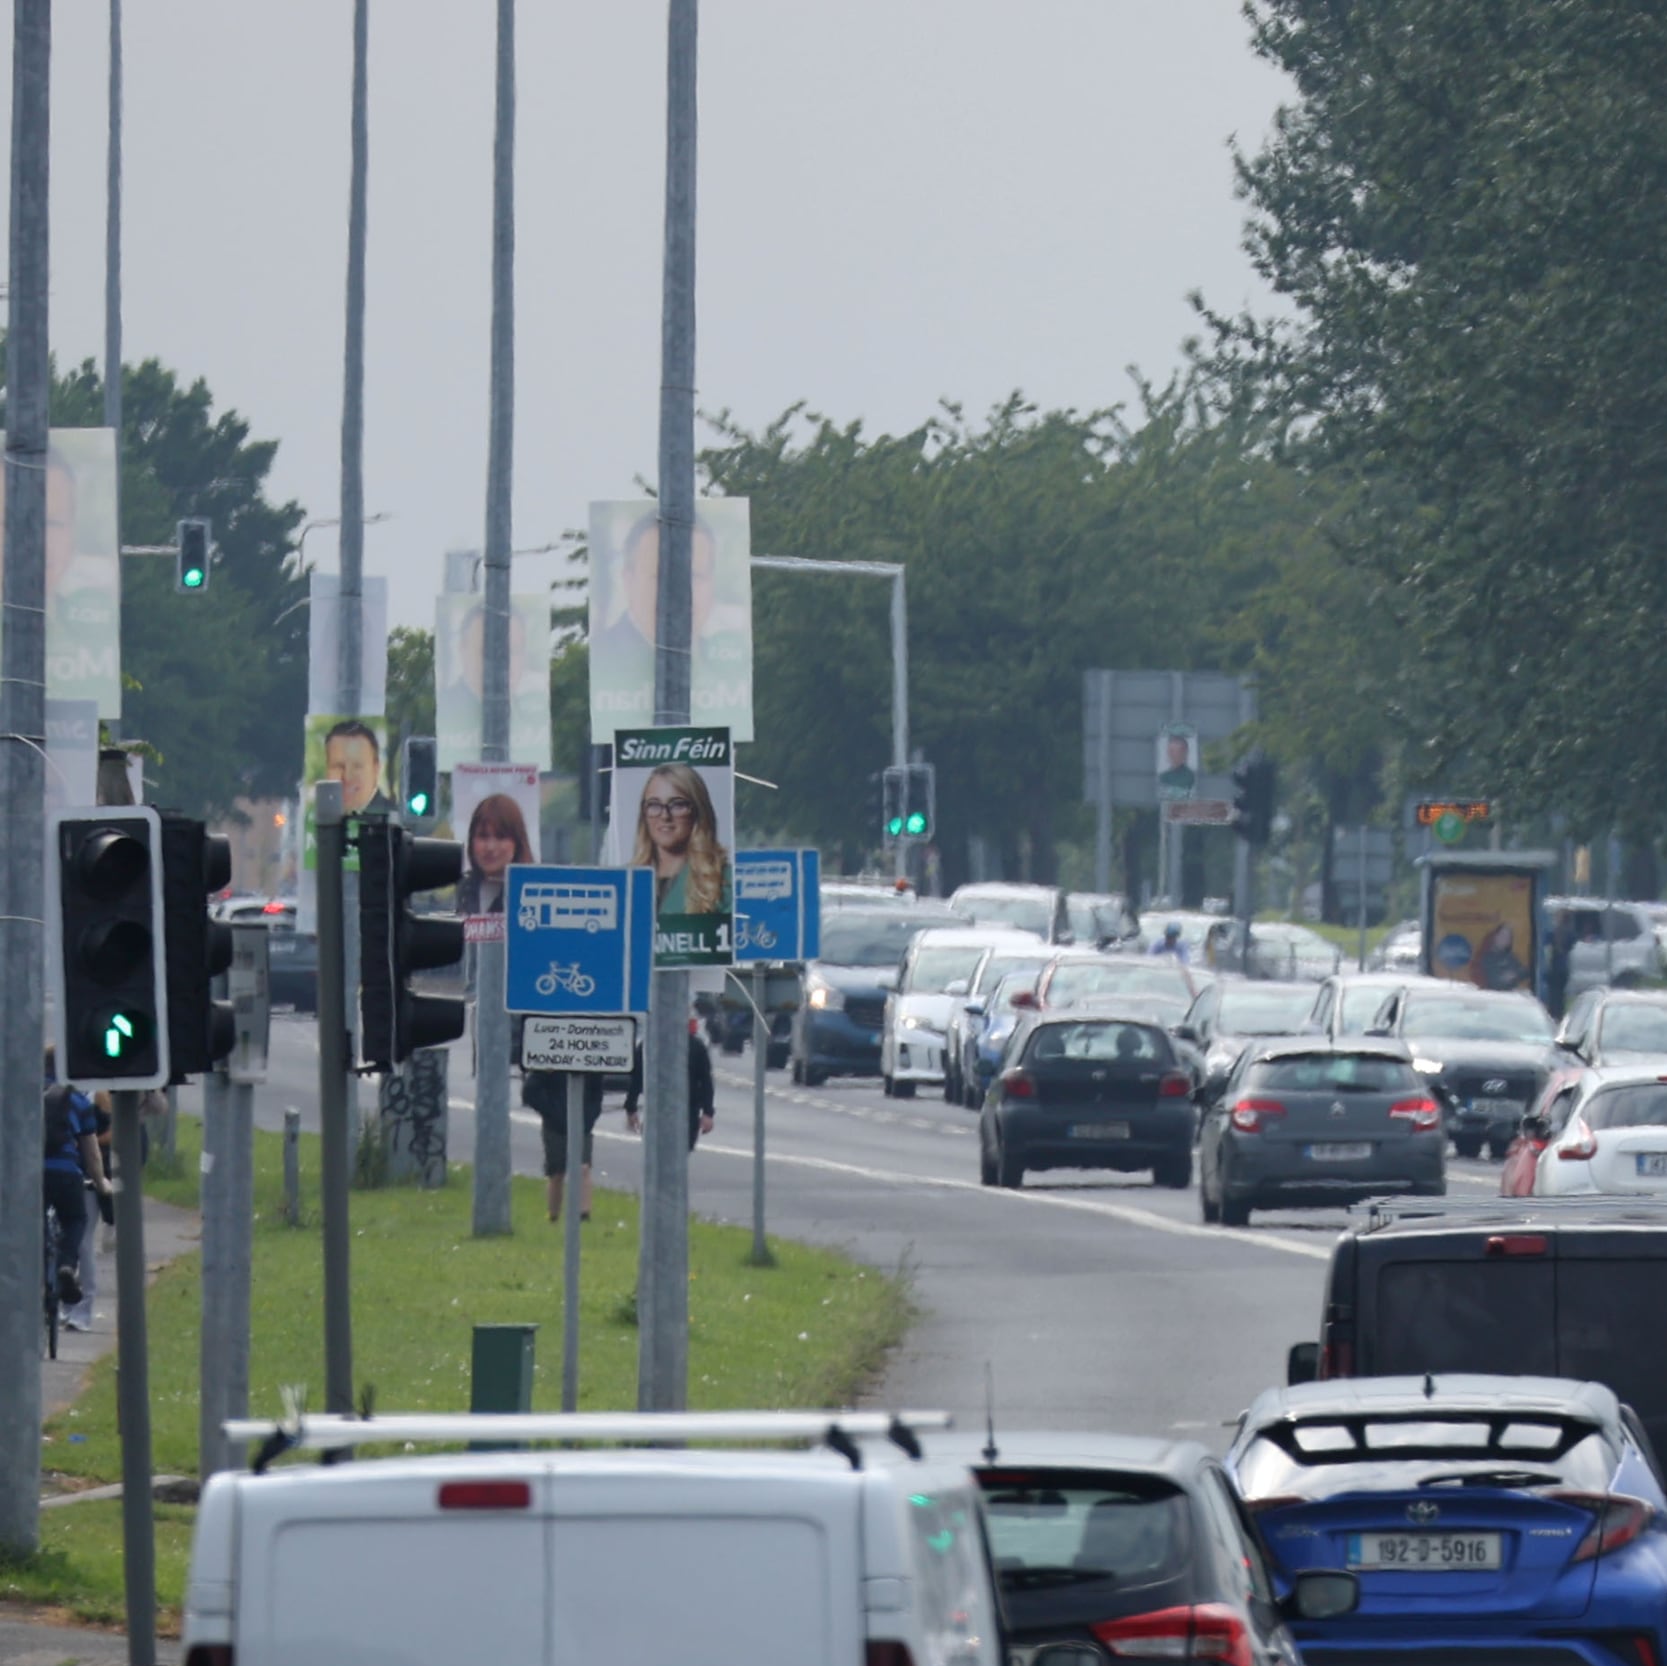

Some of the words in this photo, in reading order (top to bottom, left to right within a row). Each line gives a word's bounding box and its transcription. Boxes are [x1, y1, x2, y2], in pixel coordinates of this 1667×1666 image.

[620, 738, 671, 760] Sinn
[672, 736, 726, 760] Féin
[715, 923, 732, 952] 1
[549, 1038, 564, 1051] 24
[567, 1040, 610, 1051] HOURS
[526, 1052, 574, 1065] MONDAY
[584, 1055, 629, 1067] SUNDAY
[1378, 1538, 1487, 1562] 192-D-5916
